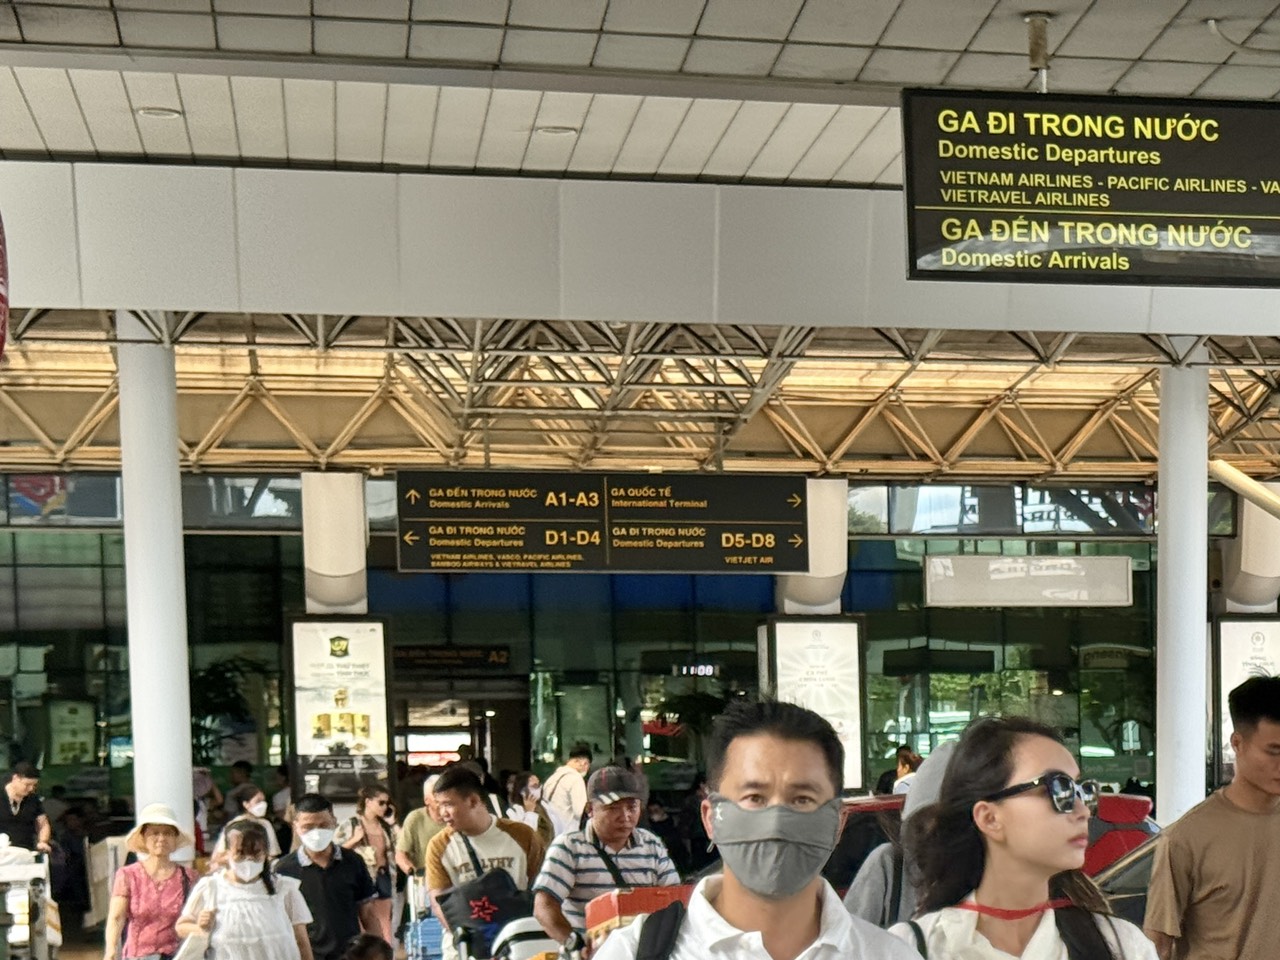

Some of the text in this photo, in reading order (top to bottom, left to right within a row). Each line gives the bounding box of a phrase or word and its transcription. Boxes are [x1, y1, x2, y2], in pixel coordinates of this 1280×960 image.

[938, 109, 1220, 142] GA ĐI TRONG NƯỚC
[938, 140, 1161, 166] Domestic Departures
[941, 172, 1014, 188] VIETNAM
[1017, 174, 1094, 190] AIRLINES
[1107, 176, 1170, 192] PACIFIC
[1174, 178, 1247, 194] AIRLINES
[941, 190, 1110, 208] VIETRAVEL AIRLINES
[941, 215, 1252, 249] GA ĐẾN TRONG NƯỚC
[941, 248, 1130, 271] Domestic Arrivals
[429, 488, 445, 498] GA
[471, 488, 507, 498] TRONG
[611, 487, 626, 497] GA
[628, 485, 656, 498] QUỐC
[429, 500, 510, 509] Domestic Arrivals
[545, 492, 600, 507] A1-A3
[611, 499, 708, 509] International Terminal
[429, 526, 445, 536] GA
[459, 526, 495, 536] TRONG
[545, 530, 601, 546] D1-D4
[612, 527, 627, 537] GA
[642, 527, 676, 537] TRONG
[429, 538, 524, 548] Domestic Departures
[612, 539, 705, 549] Domestic Departures
[721, 532, 776, 548] D5-D8
[725, 556, 757, 564] VIETJET
[452, 857, 515, 874] WELTHY
